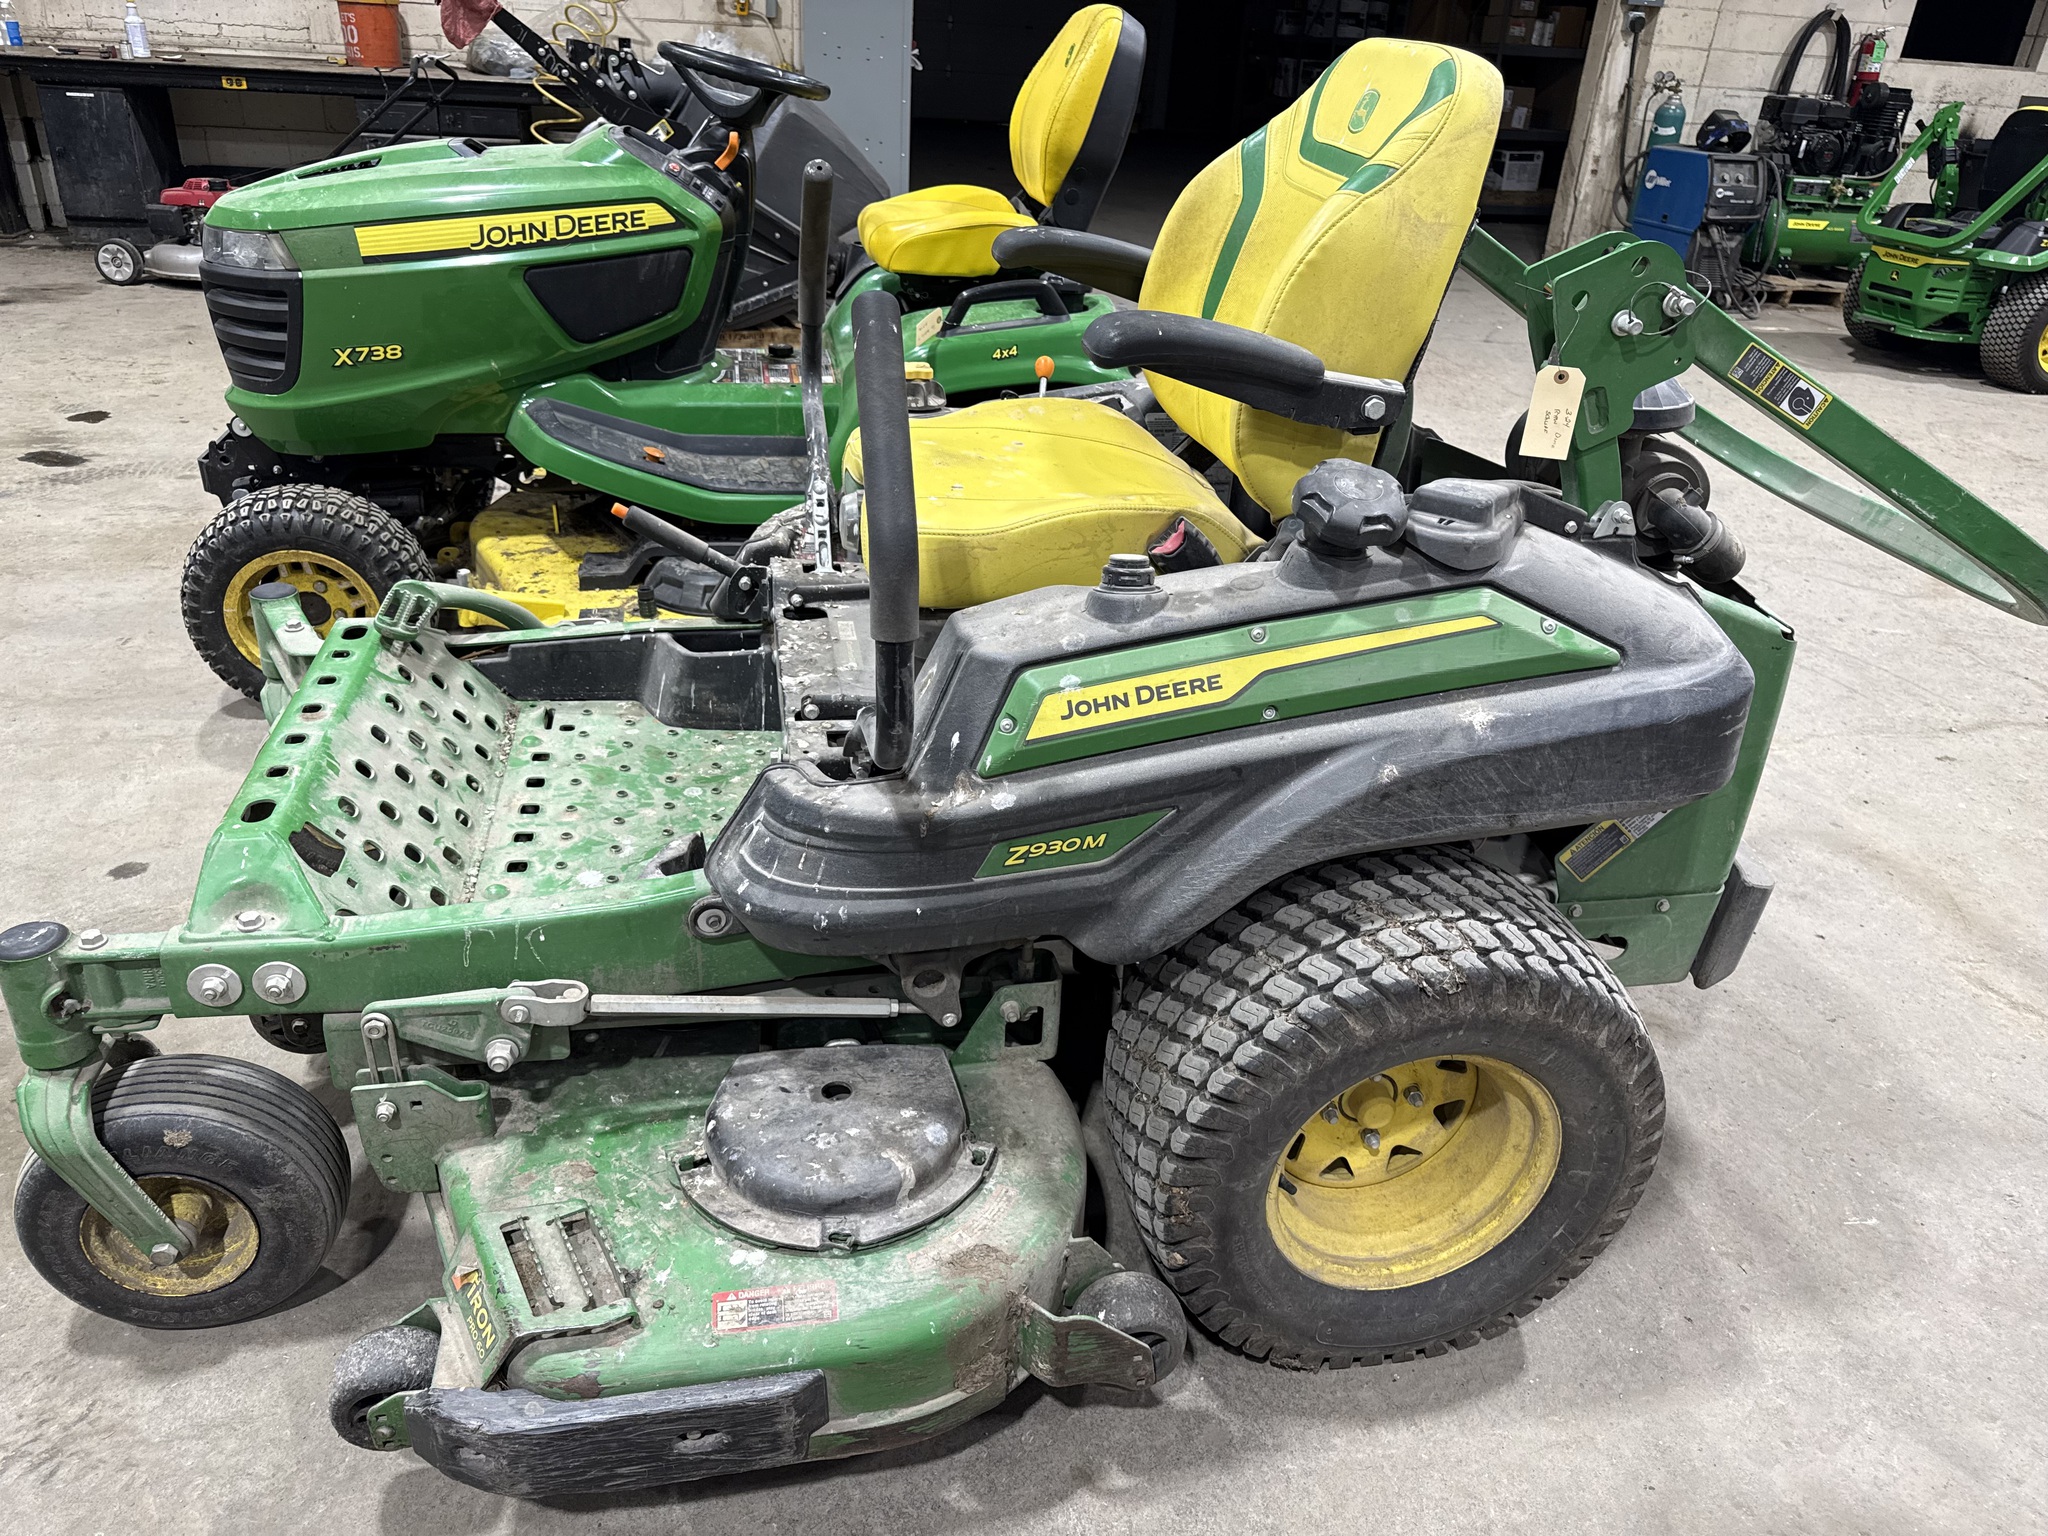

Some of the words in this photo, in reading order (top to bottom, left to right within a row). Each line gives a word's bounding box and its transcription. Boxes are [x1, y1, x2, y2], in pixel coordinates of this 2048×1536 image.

[470, 219, 548, 248] JOHN
[554, 209, 646, 237] DEERE
[1882, 250, 1898, 260] JOHN
[1899, 252, 1920, 265] DEERE
[333, 344, 402, 367] X738
[992, 345, 1018, 360] 4x4
[1805, 401, 1827, 427] CAUTION
[1060, 691, 1130, 720] JOHN
[1135, 673, 1223, 706] DEERE
[1003, 832, 1107, 867] Z930M
[738, 1288, 770, 1300] DANGER
[466, 1315, 479, 1341] PRO
[476, 1341, 485, 1359] 60
